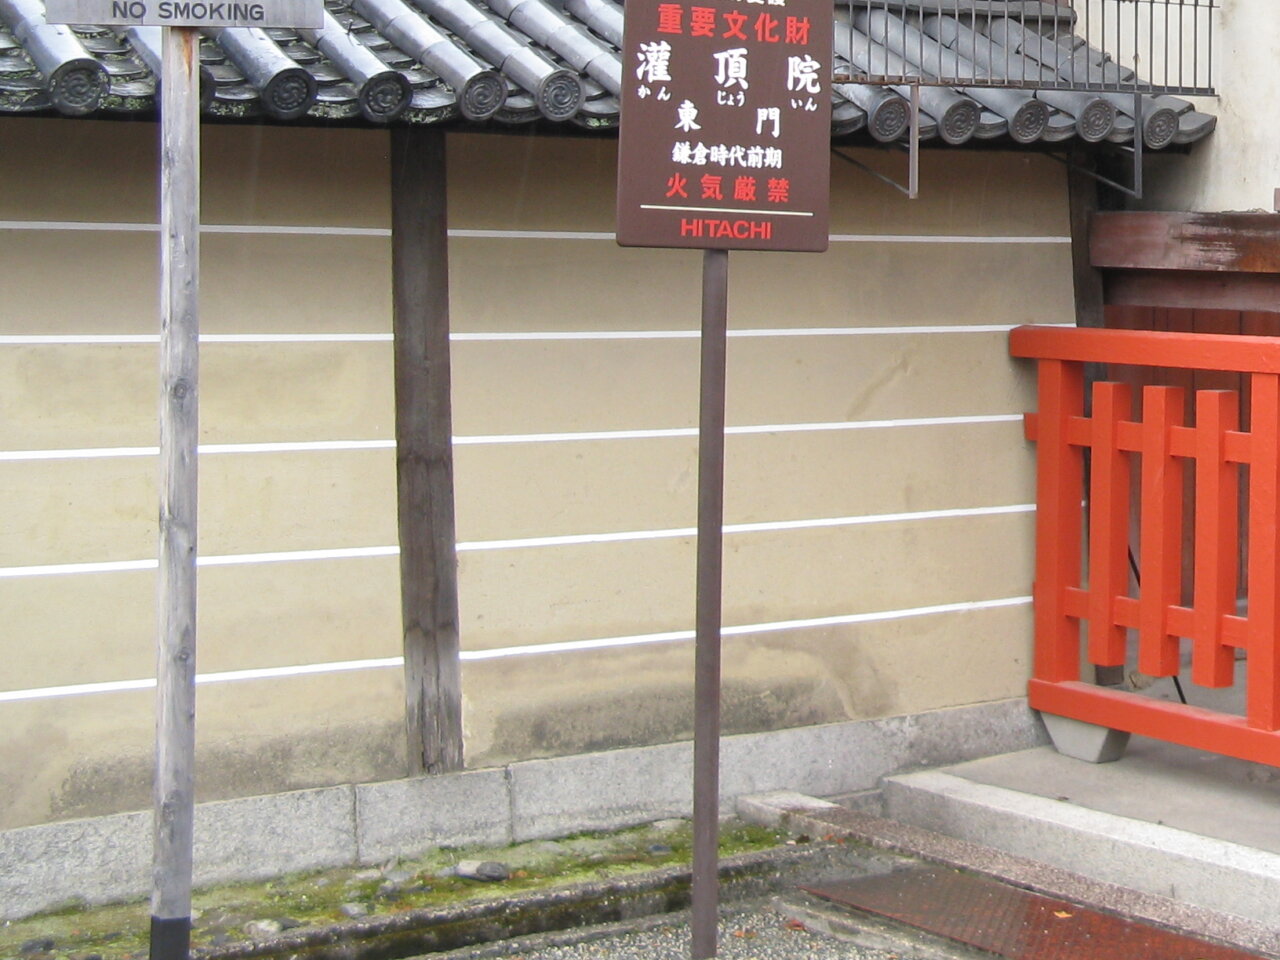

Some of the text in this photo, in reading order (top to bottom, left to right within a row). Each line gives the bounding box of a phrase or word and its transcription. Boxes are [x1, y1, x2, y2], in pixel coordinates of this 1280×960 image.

[112, 0, 265, 21] NO SMOKING
[656, 3, 811, 45] 重要文化財
[637, 85, 818, 112] かん じょう いん
[674, 98, 781, 138] 東門
[671, 141, 783, 169] 鎌倉時代前期
[665, 172, 790, 203] 火気厳禁
[680, 218, 772, 239] HITACHI
